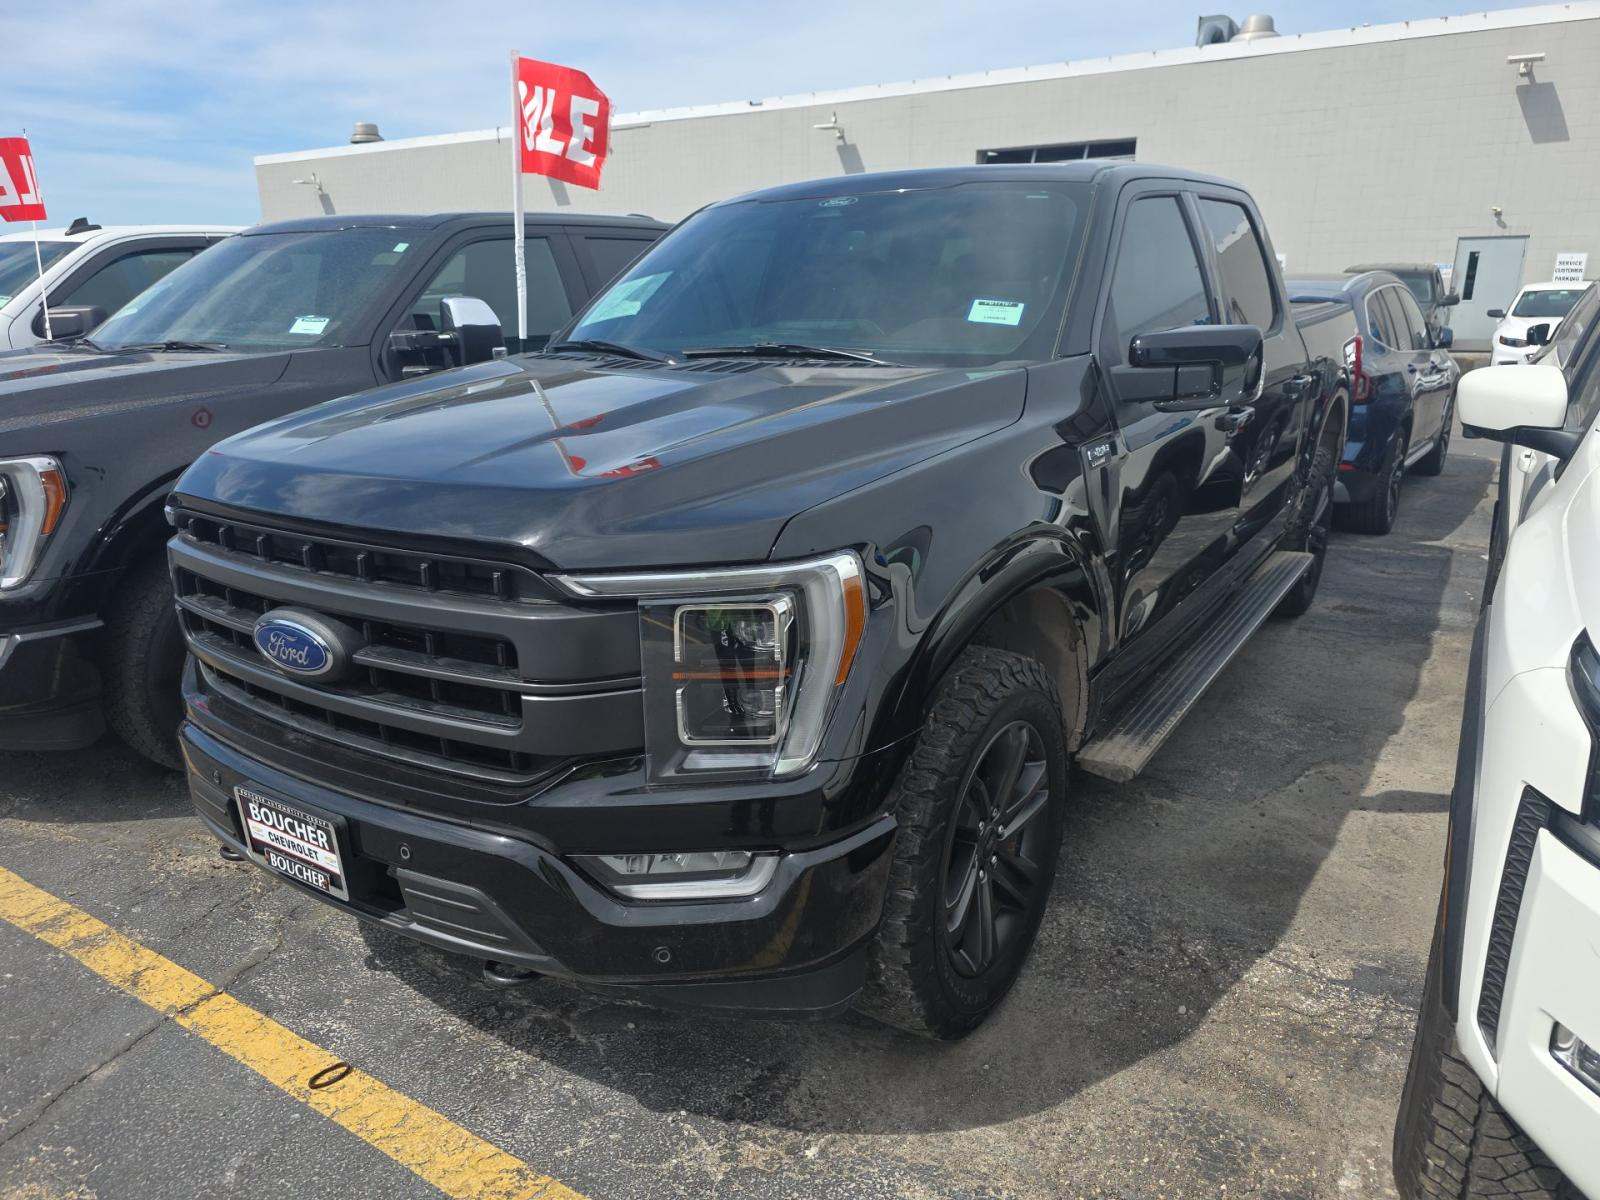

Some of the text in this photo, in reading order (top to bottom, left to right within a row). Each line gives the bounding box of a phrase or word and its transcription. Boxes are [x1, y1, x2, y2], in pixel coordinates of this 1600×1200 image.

[268, 630, 310, 665] Ford
[248, 802, 329, 850] BOUCHER
[268, 831, 320, 861] CHEVROLET
[269, 853, 327, 888] BOUCHER
